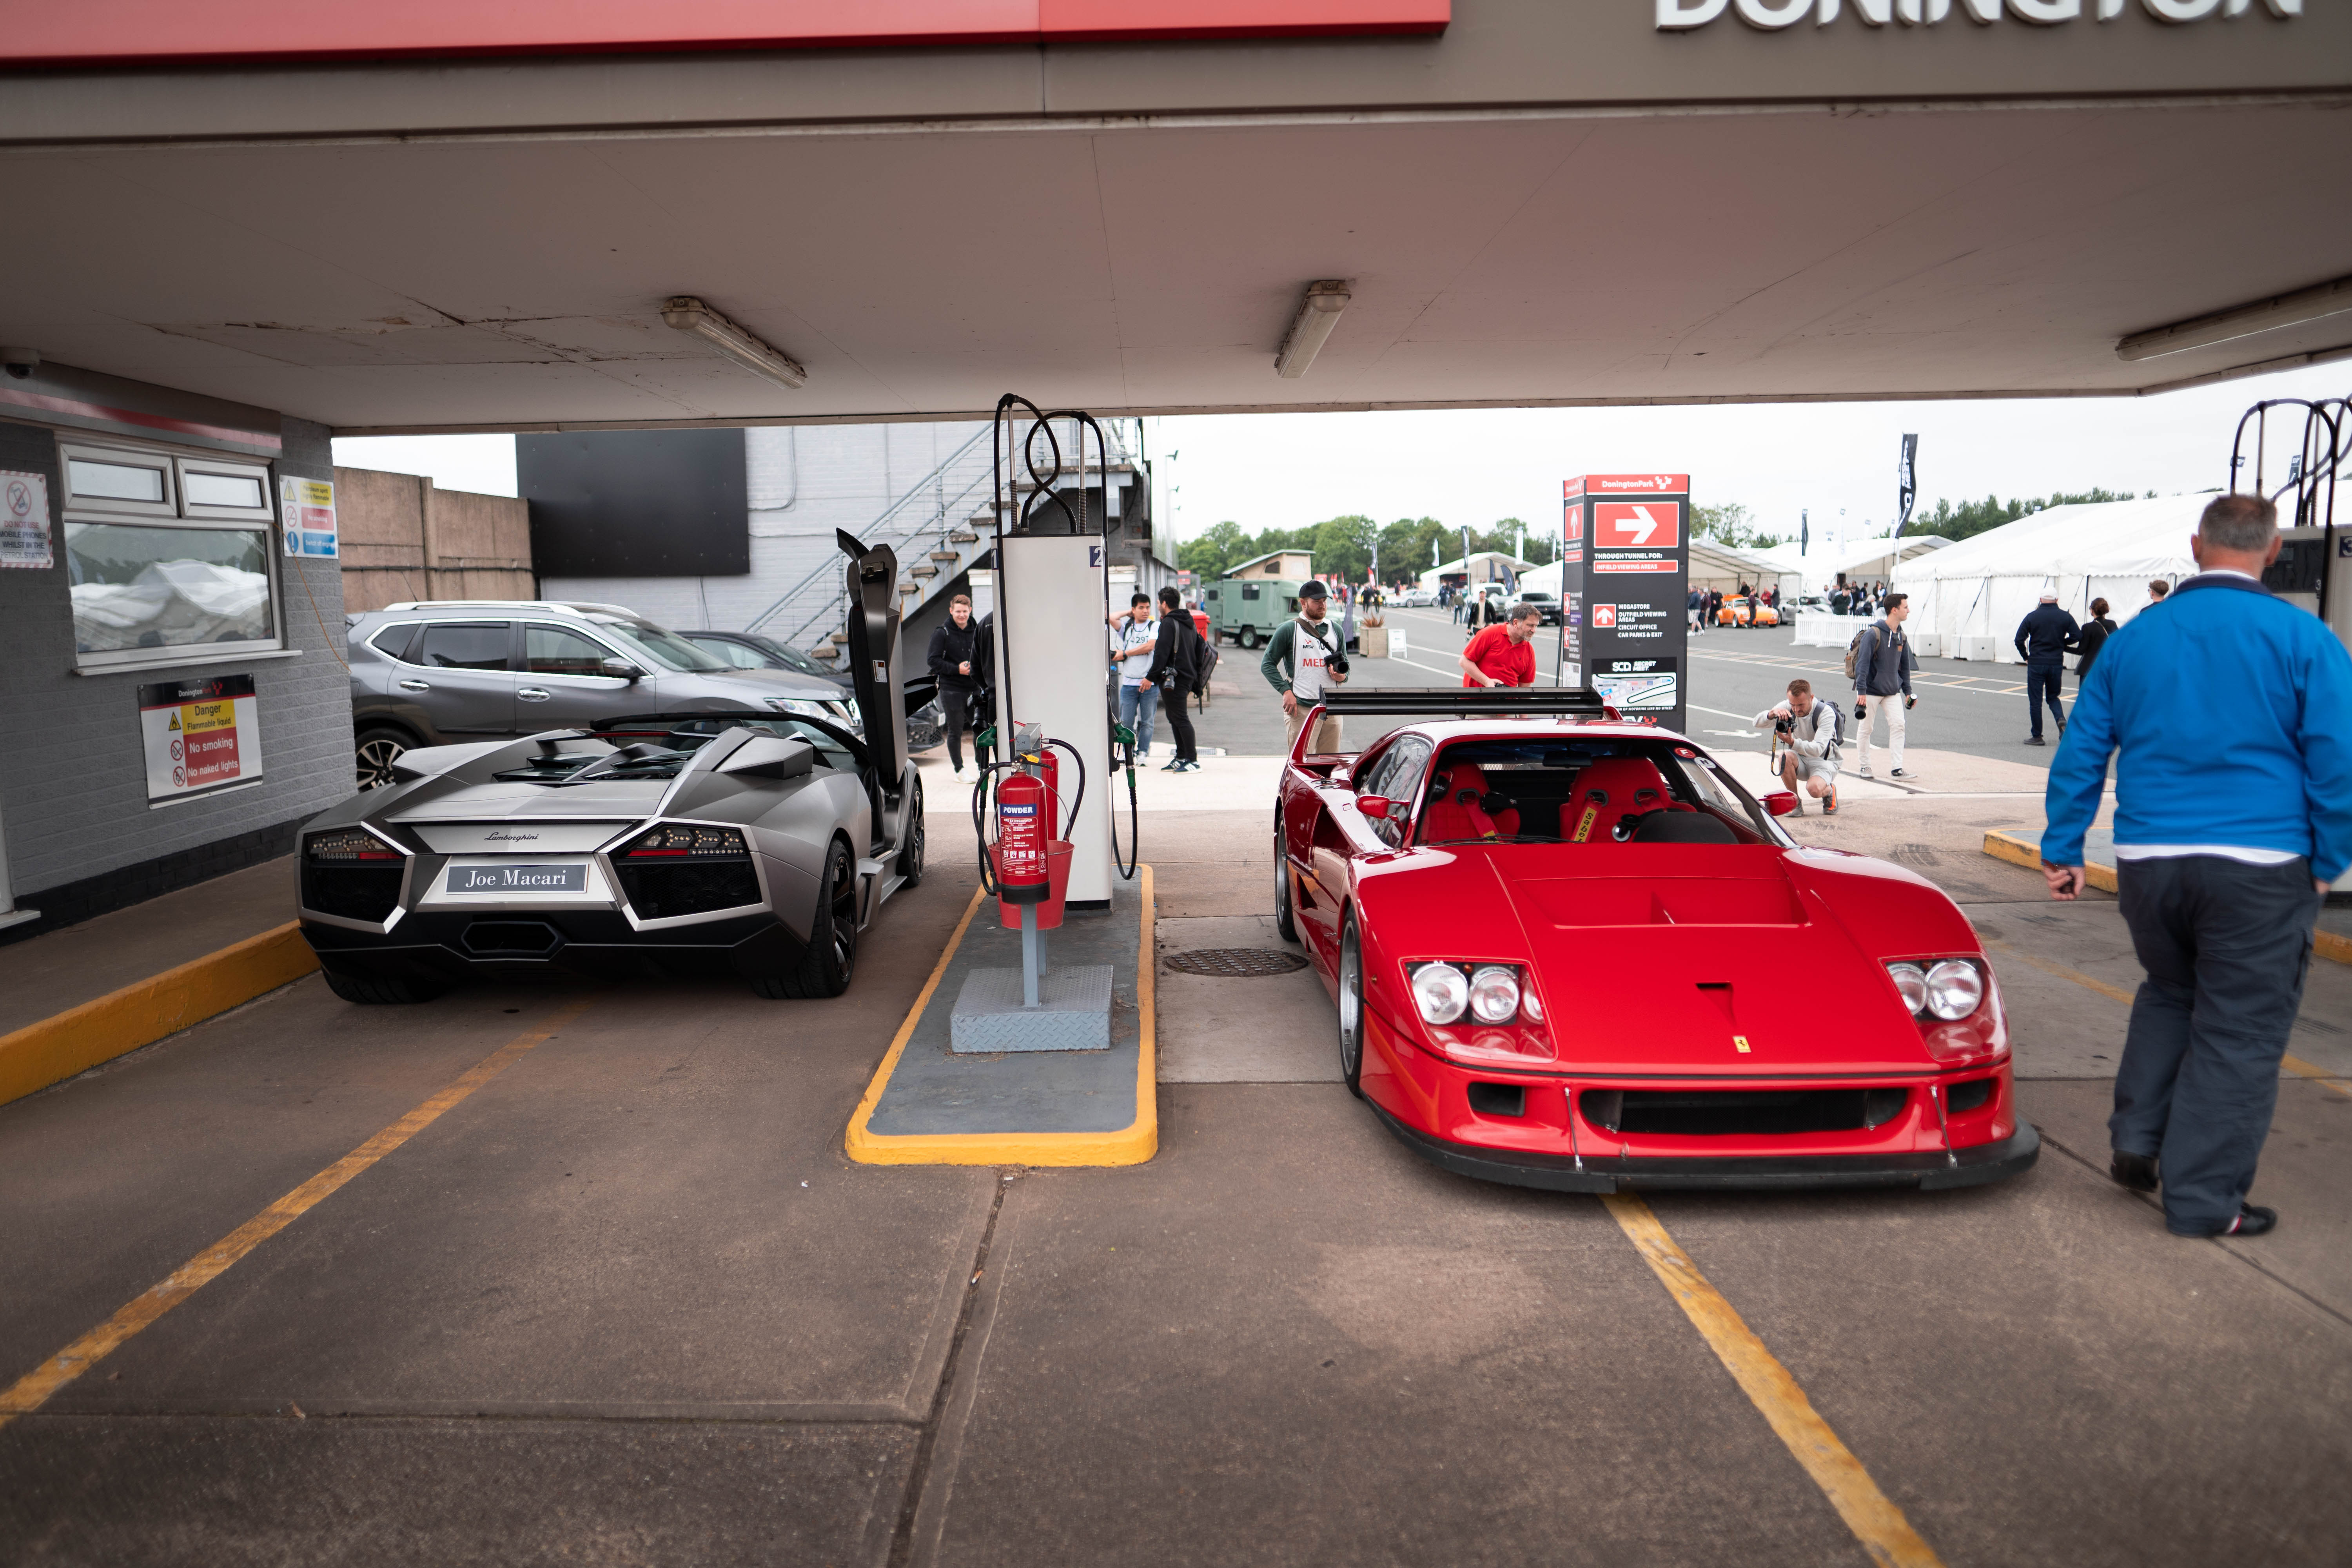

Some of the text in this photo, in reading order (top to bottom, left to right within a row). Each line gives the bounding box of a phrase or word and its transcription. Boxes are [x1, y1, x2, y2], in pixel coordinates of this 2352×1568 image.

[1602, 481, 1653, 489] DoningtonPark
[2343, 537, 2352, 556] 3
[991, 550, 997, 568] 1
[1094, 547, 1103, 566] 2
[2316, 579, 2321, 590] 3
[1303, 658, 1327, 667] MED
[195, 705, 221, 717] Danger
[187, 717, 231, 731] Flammable liquid
[189, 738, 233, 754] No smoking
[188, 760, 238, 777] No naked lights
[1578, 813, 1593, 842] Sabel
[485, 832, 539, 842] Lamborghini
[465, 869, 566, 888] Joe Macari
